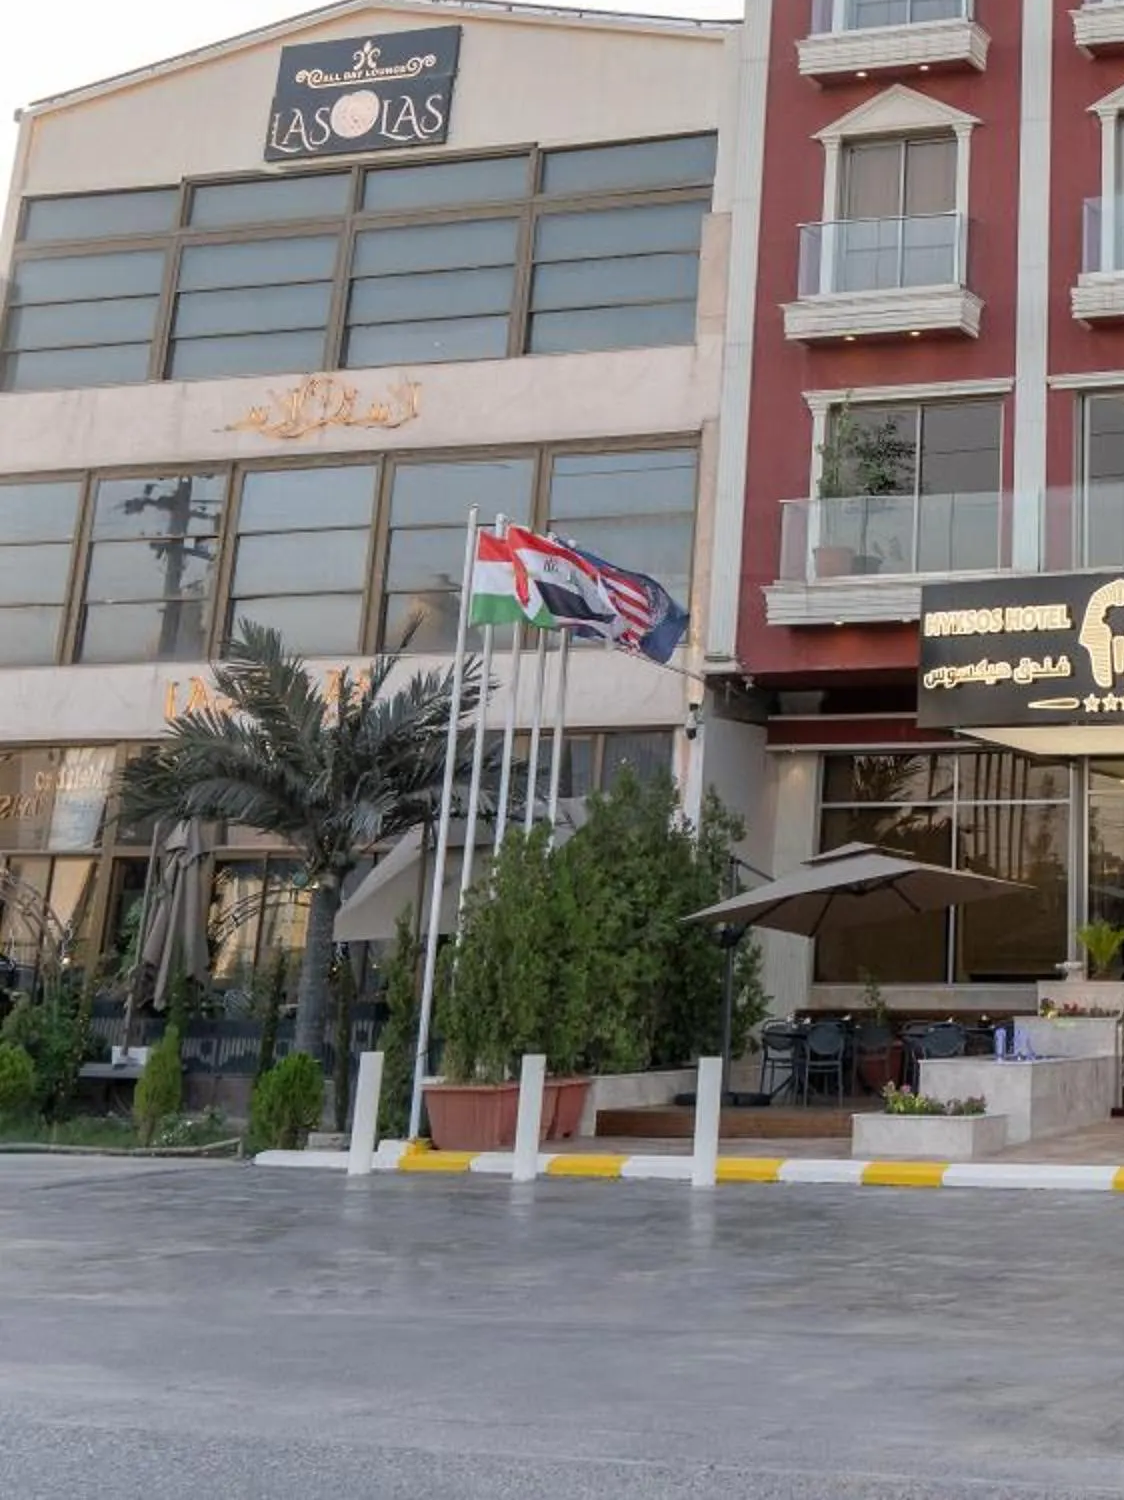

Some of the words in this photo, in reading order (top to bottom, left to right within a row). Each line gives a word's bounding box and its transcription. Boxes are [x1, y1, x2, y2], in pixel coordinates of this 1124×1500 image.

[924, 607, 1004, 636] HYKSOS
[1005, 604, 1071, 631] HOTEL
[1013, 655, 1071, 684] فندق
